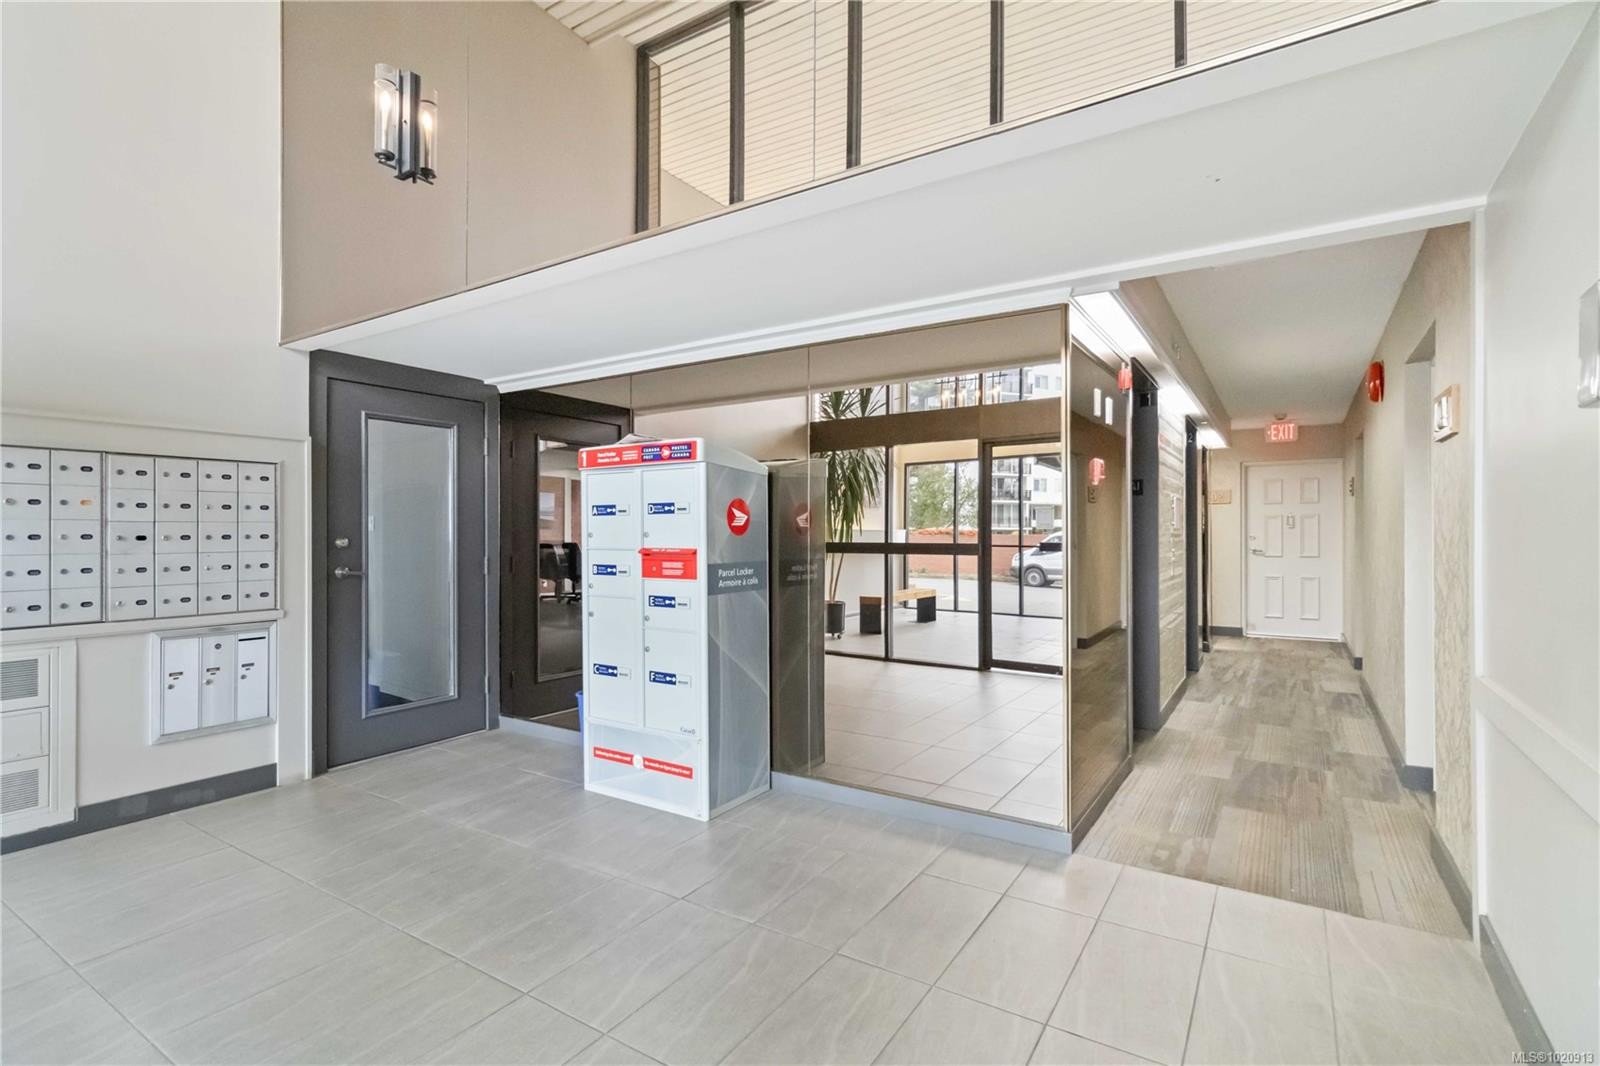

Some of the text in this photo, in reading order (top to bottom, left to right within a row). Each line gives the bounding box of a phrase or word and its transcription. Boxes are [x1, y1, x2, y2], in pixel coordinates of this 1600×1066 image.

[1271, 424, 1295, 440] EXIT
[1187, 432, 1193, 443] 2
[581, 451, 587, 467] 1
[592, 506, 598, 515] A
[648, 504, 654, 514] D
[718, 567, 754, 578] Parcel Locker
[718, 578, 742, 588] Armoire
[747, 576, 759, 585] colis
[650, 597, 655, 606] E
[594, 665, 600, 674] C
[650, 672, 656, 681] F
